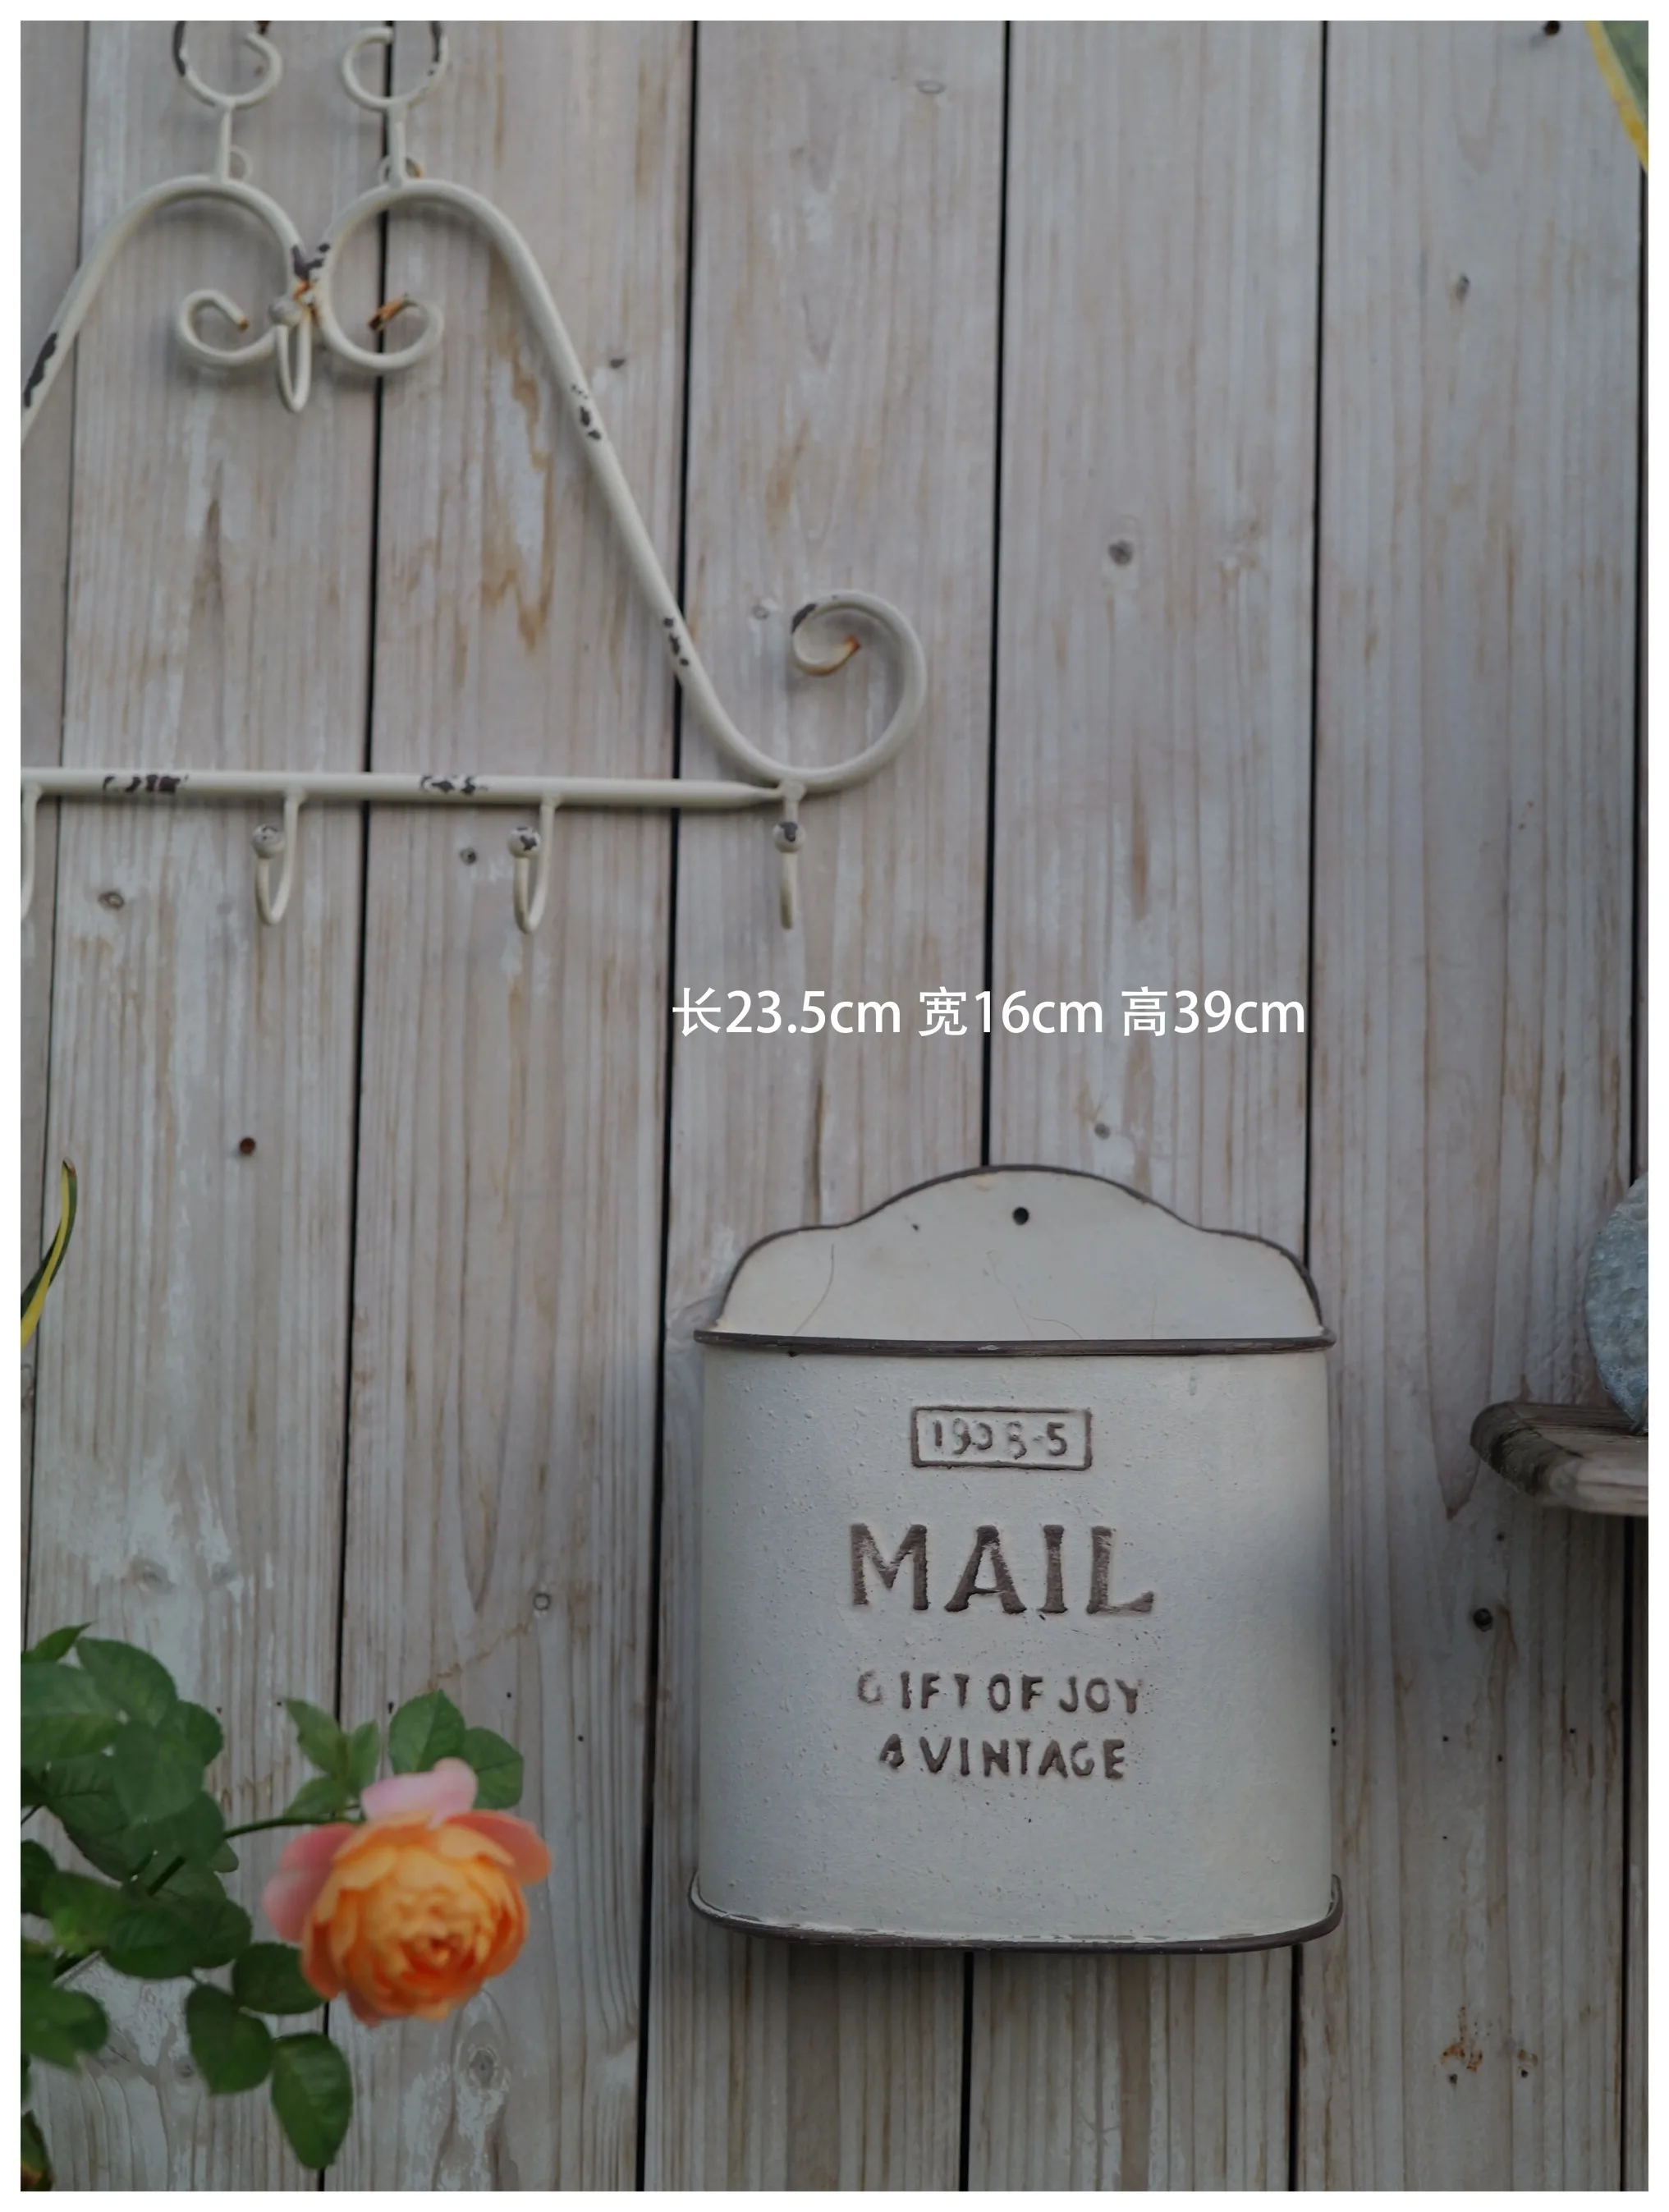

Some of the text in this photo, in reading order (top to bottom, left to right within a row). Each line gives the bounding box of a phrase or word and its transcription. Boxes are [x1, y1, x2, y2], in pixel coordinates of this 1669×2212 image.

[851, 1523, 1155, 1614] MAIL
[857, 1671, 1144, 1714] GIFT OF JOY
[919, 1736, 1126, 1779] VINTAGE
